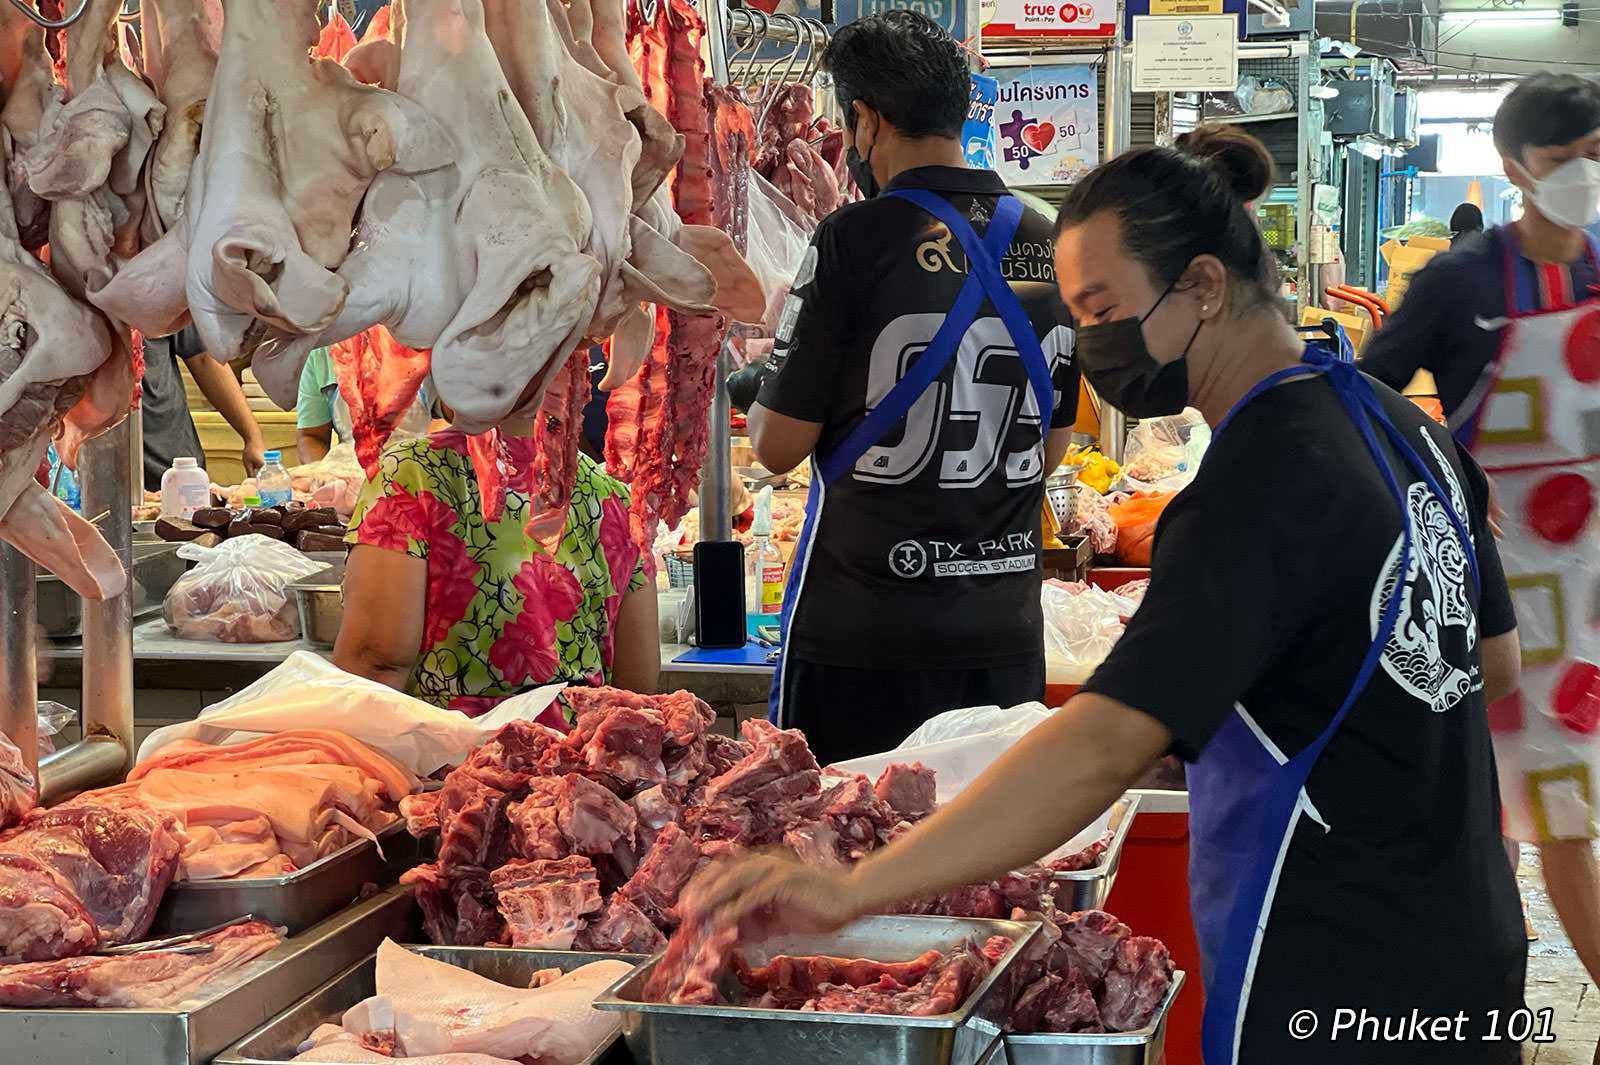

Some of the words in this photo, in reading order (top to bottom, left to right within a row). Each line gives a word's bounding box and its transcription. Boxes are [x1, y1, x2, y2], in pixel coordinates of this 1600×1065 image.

[1023, 3, 1056, 16] true
[1044, 16, 1056, 24] Pay
[996, 81, 1090, 103] มโครงการ
[1059, 124, 1076, 138] 50
[1012, 145, 1029, 159] 50
[929, 541, 967, 559] TX
[937, 562, 989, 574] SOCCER
